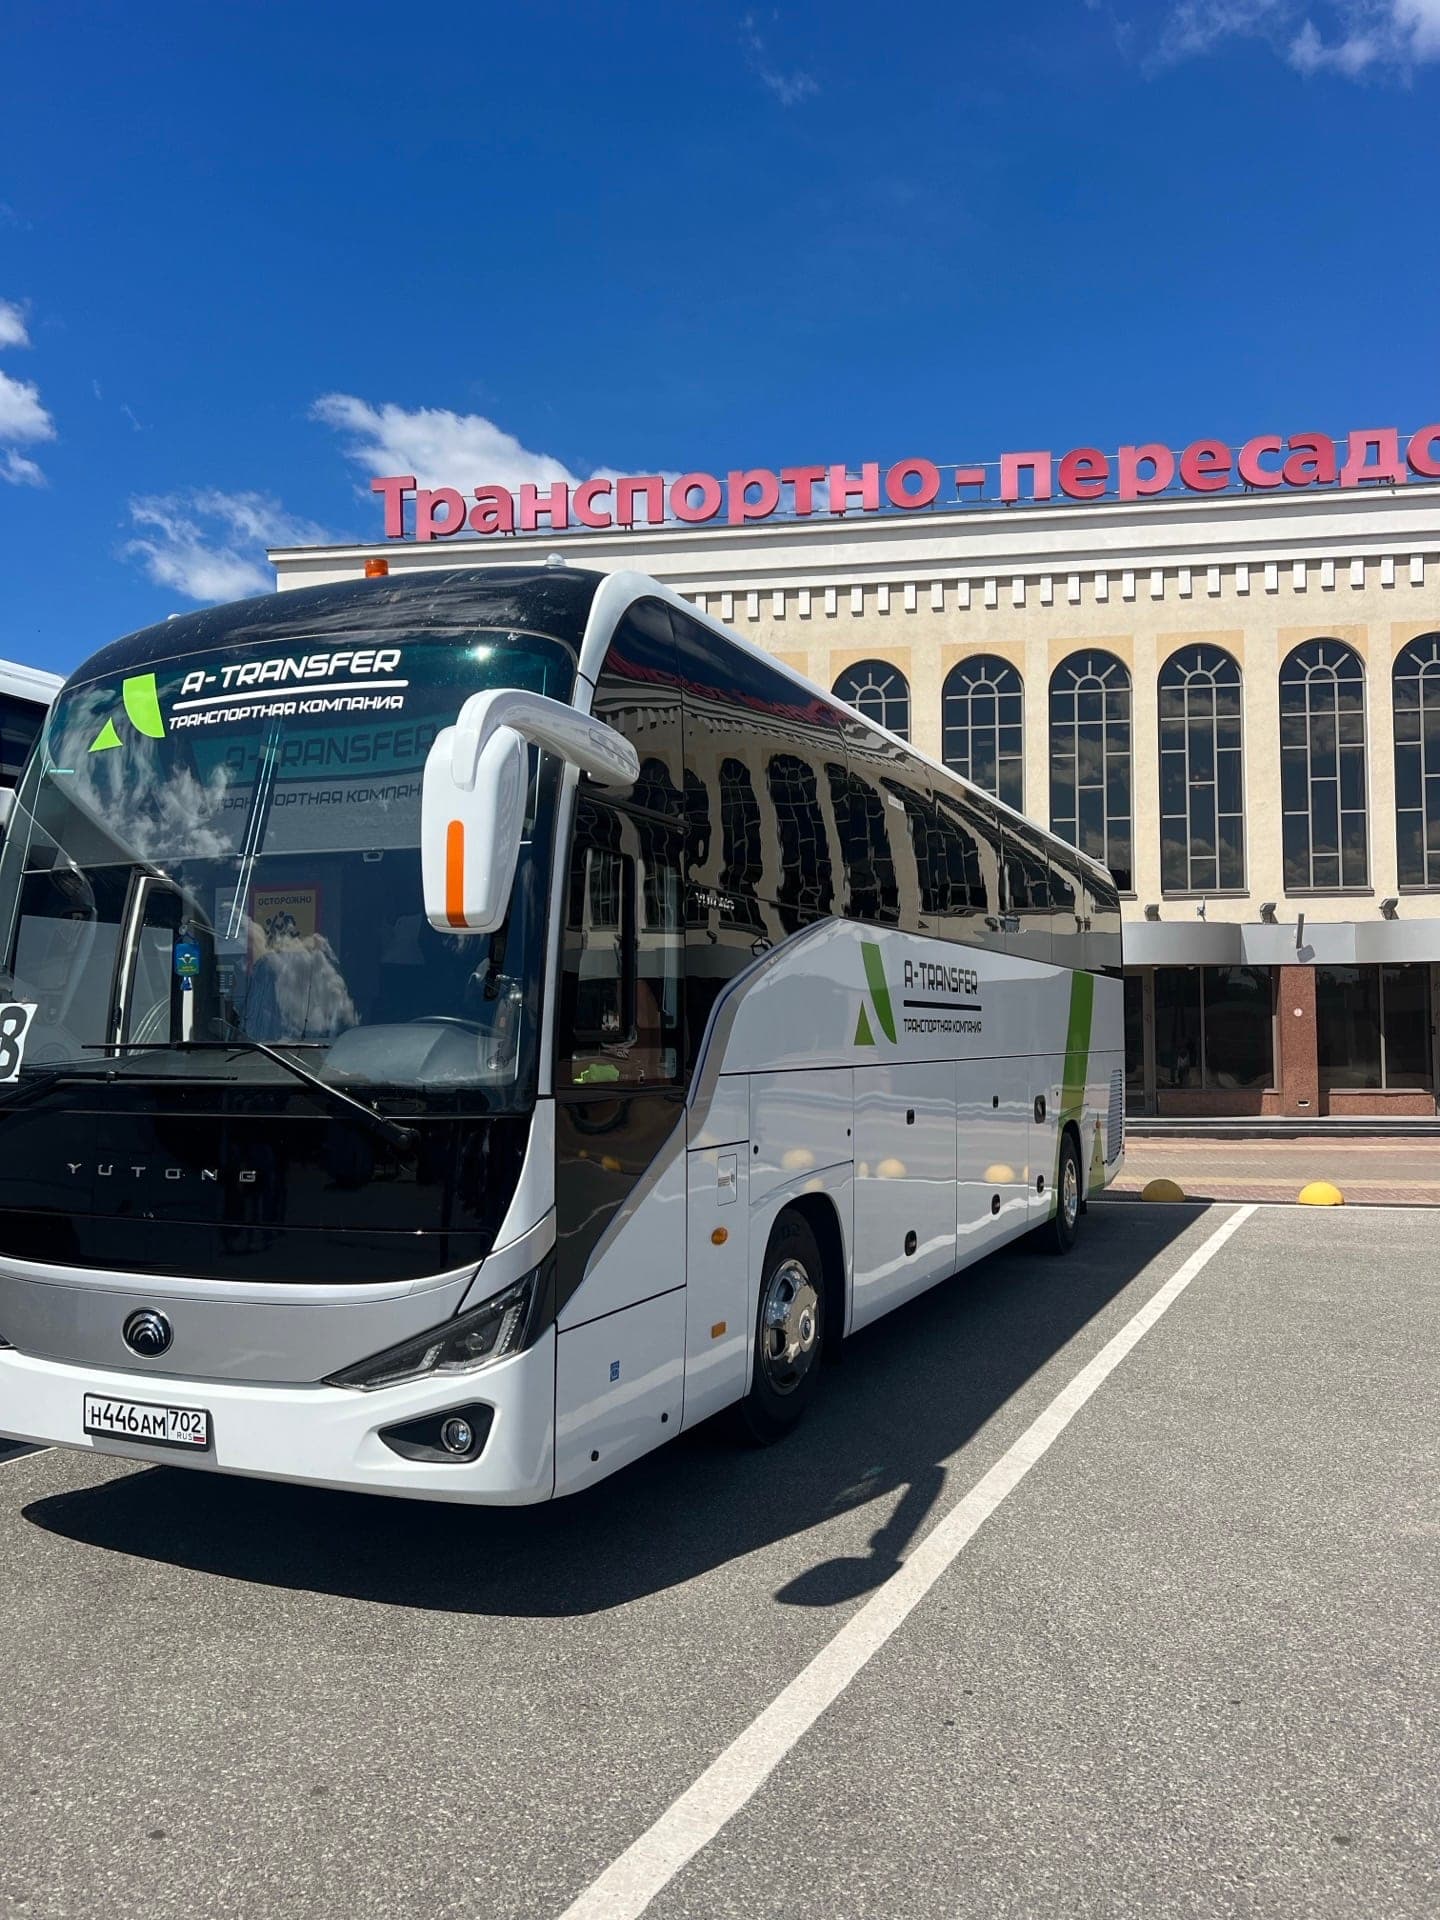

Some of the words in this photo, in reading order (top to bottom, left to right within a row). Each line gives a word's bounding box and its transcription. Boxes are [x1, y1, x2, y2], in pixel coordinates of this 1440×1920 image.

[180, 649, 402, 695] A-TRANSFER
[169, 701, 297, 730] ТРАНСПОРТНАЯ
[298, 695, 405, 714] КОМПАНИЯ
[904, 960, 978, 995] A-TRANSFER
[67, 1163, 256, 1182] YUTONG
[177, 1431, 193, 1441] RUS
